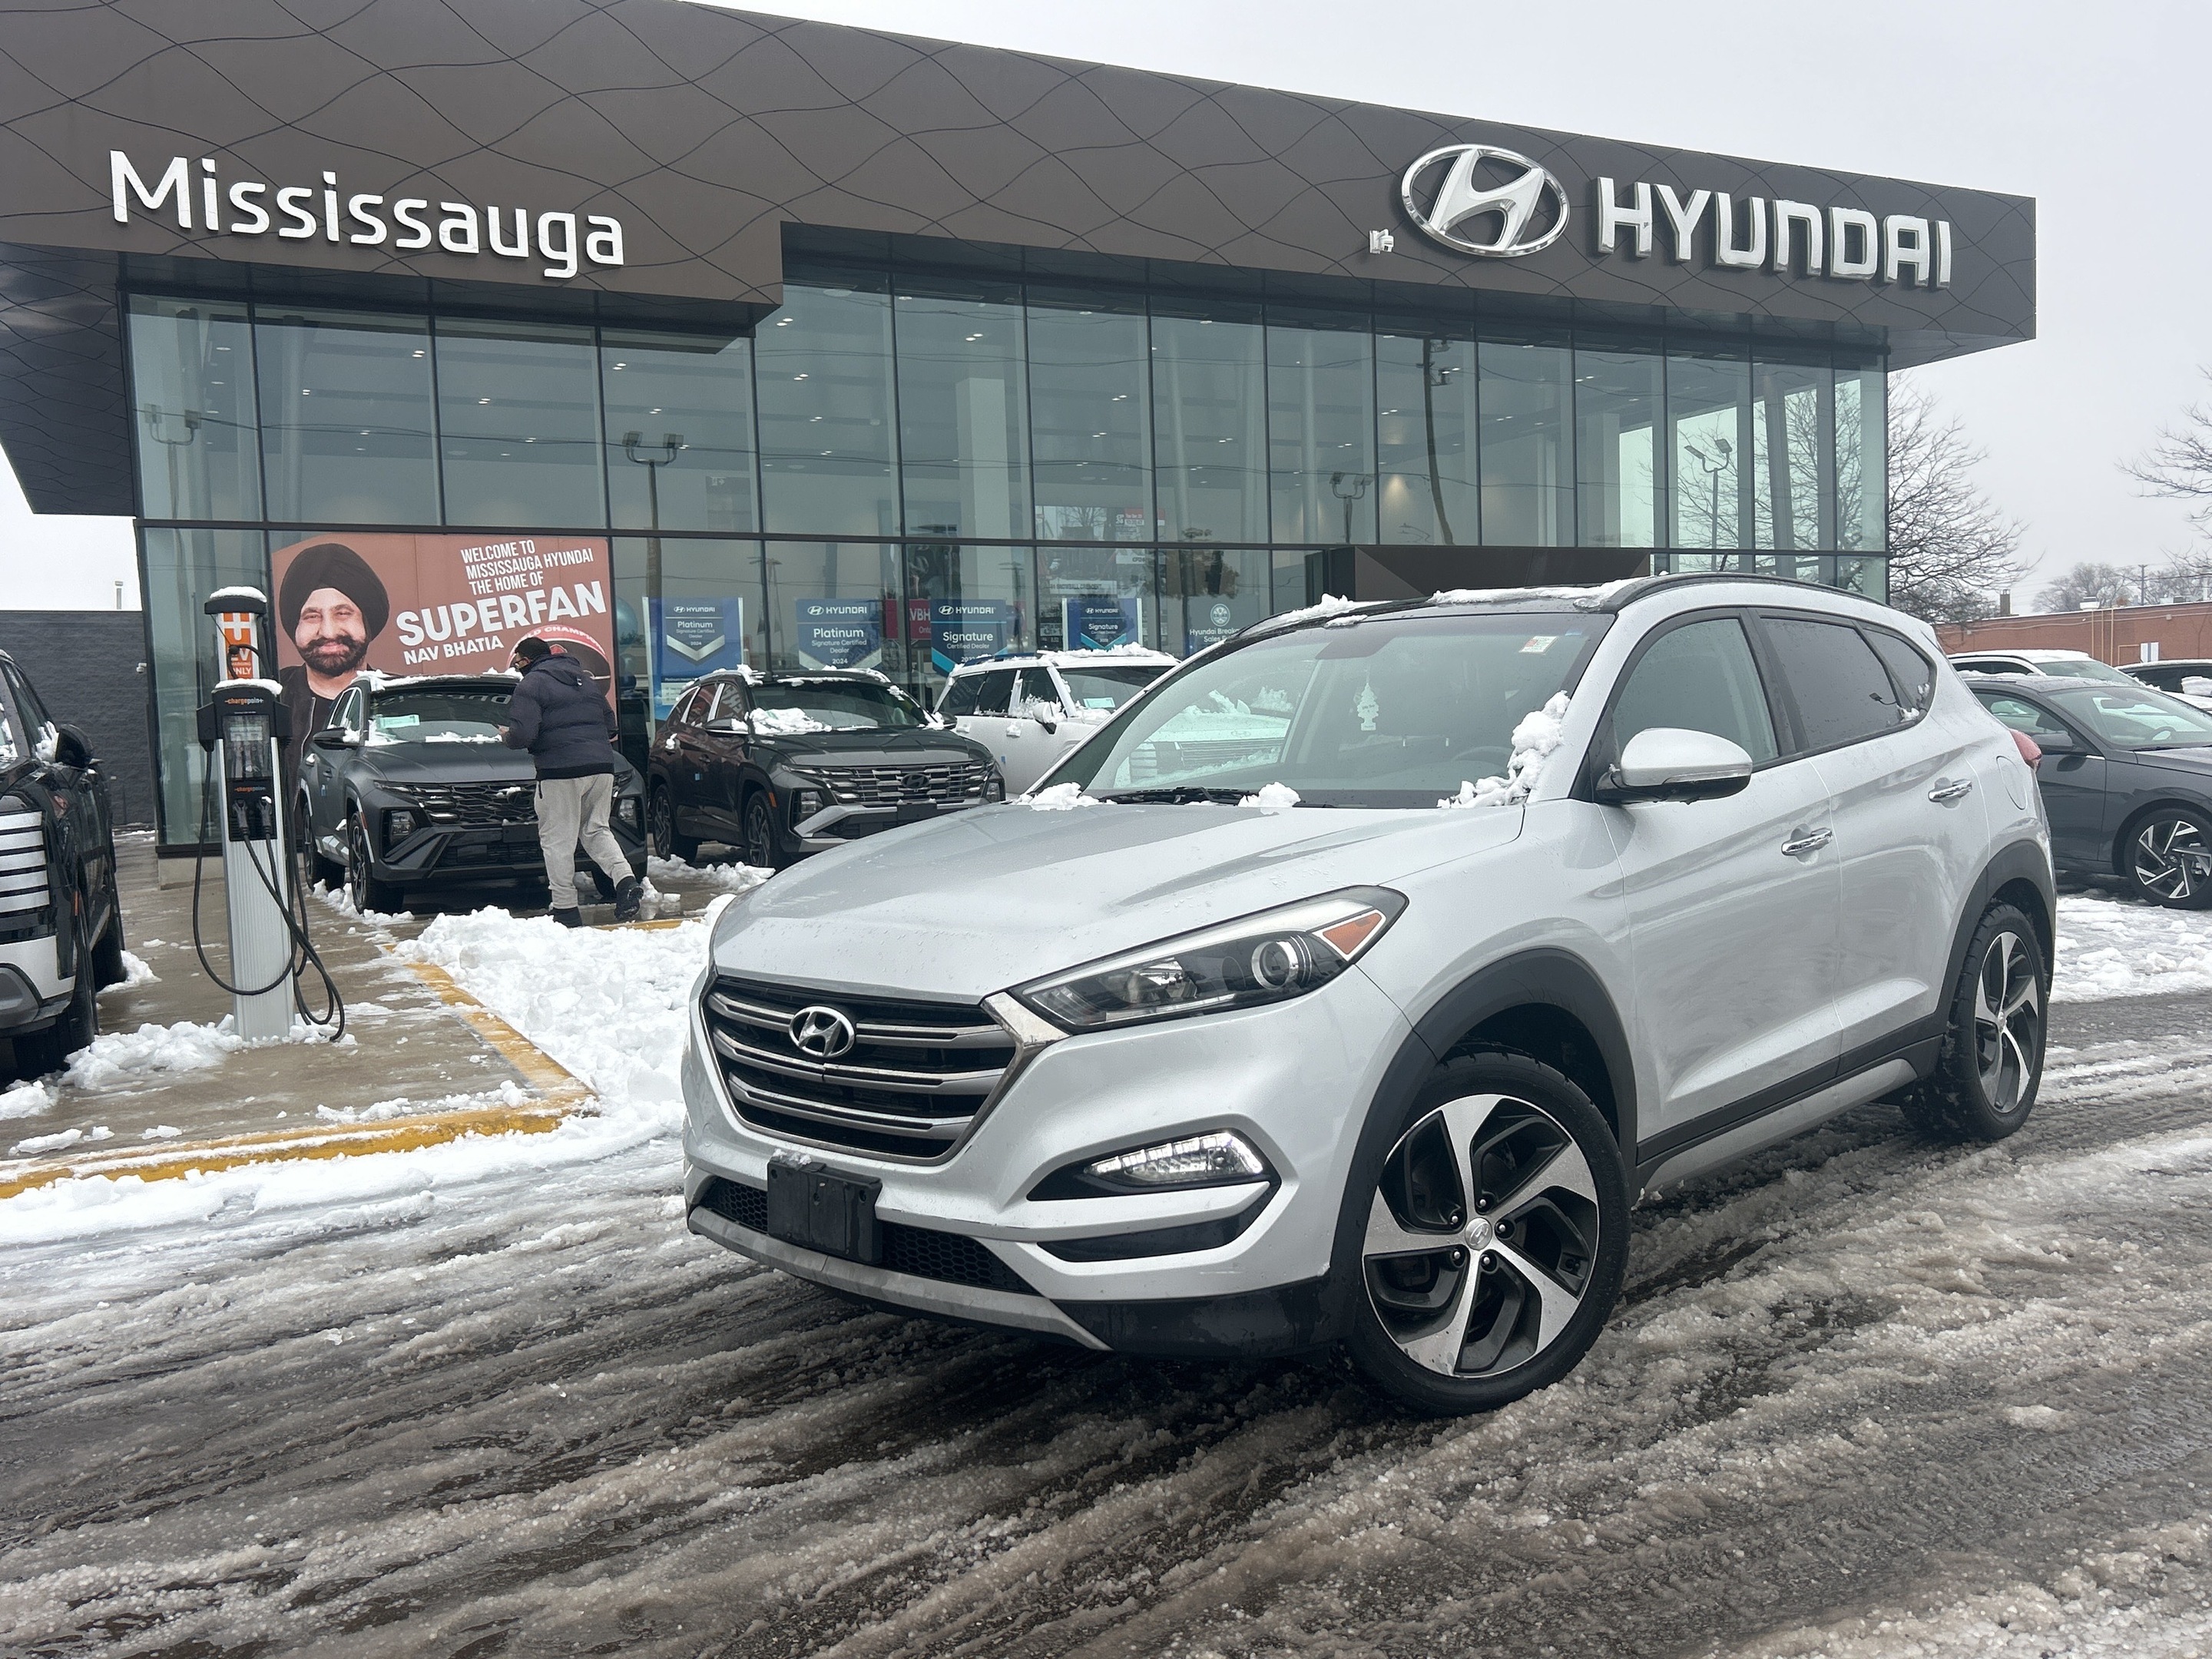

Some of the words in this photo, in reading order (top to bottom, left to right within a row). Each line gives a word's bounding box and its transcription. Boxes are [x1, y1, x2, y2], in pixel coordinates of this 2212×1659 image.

[110, 150, 624, 279] Mississauga
[1597, 176, 1952, 290] HYUNDAI
[461, 541, 519, 564] WELCOME
[519, 539, 536, 555] TO
[465, 555, 543, 580] MISSISSAUGA
[543, 548, 594, 568] HYUNDAI
[469, 578, 494, 596] THE
[494, 573, 529, 592] HOME
[529, 571, 545, 587] OF
[396, 581, 607, 647] SUPERFAN
[813, 628, 864, 638] Platinum
[942, 631, 994, 643] Signature
[403, 645, 439, 666] NAV
[443, 635, 505, 657] BHATIA
